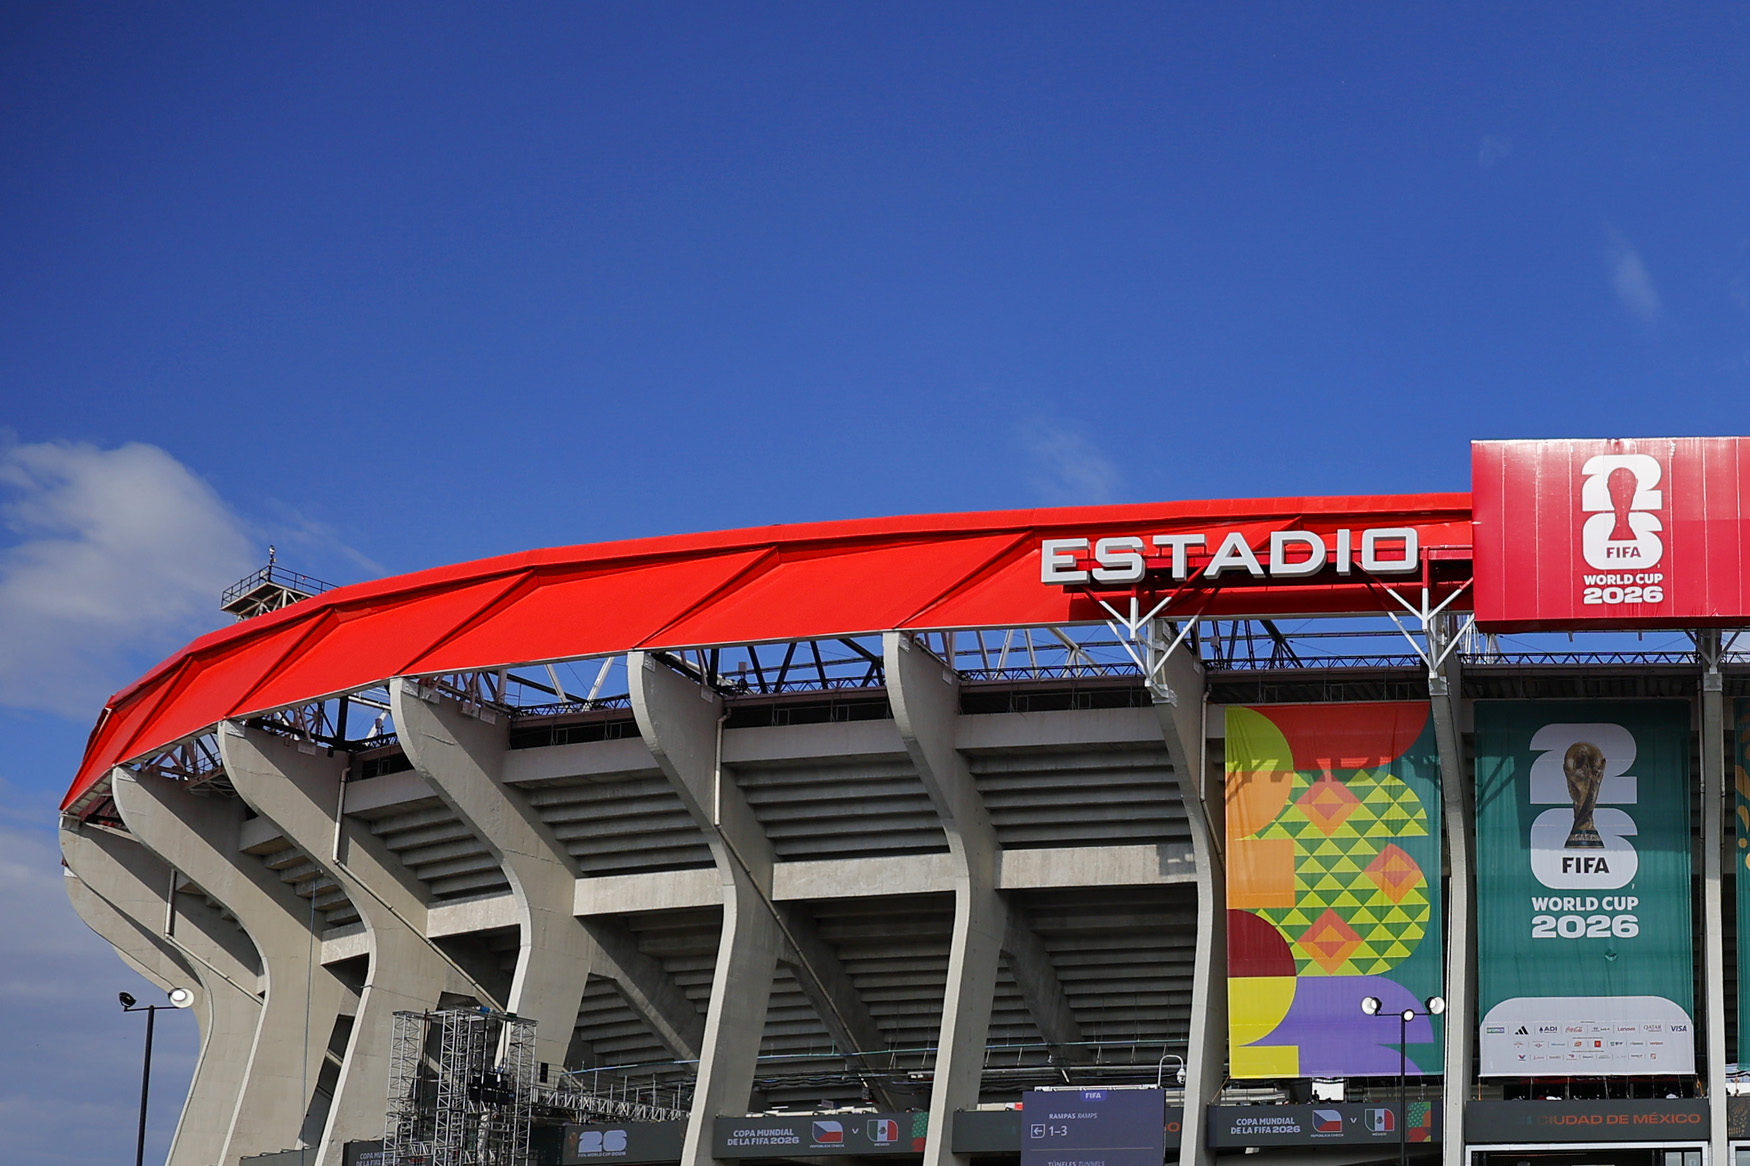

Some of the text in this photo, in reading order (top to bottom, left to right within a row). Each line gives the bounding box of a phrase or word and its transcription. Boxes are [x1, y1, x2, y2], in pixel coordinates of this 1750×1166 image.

[1040, 527, 1419, 585] ESTADIO
[1606, 546, 1642, 559] FIFA
[1583, 573, 1664, 586] WORLD CUP
[1583, 586, 1664, 605] 2026
[1562, 857, 1610, 874] FIFA
[1531, 896, 1640, 911] WORLD CUP
[1531, 914, 1640, 939] 2026
[1236, 1117, 1295, 1126] COPA MUNDIAL
[1606, 1112, 1702, 1124] DE MÉXICO
[733, 1128, 795, 1139] COPA MUNDIAL
[1230, 1125, 1301, 1135] DE LA FIFA 2026
[750, 1136, 800, 1146] FIFA 2026
